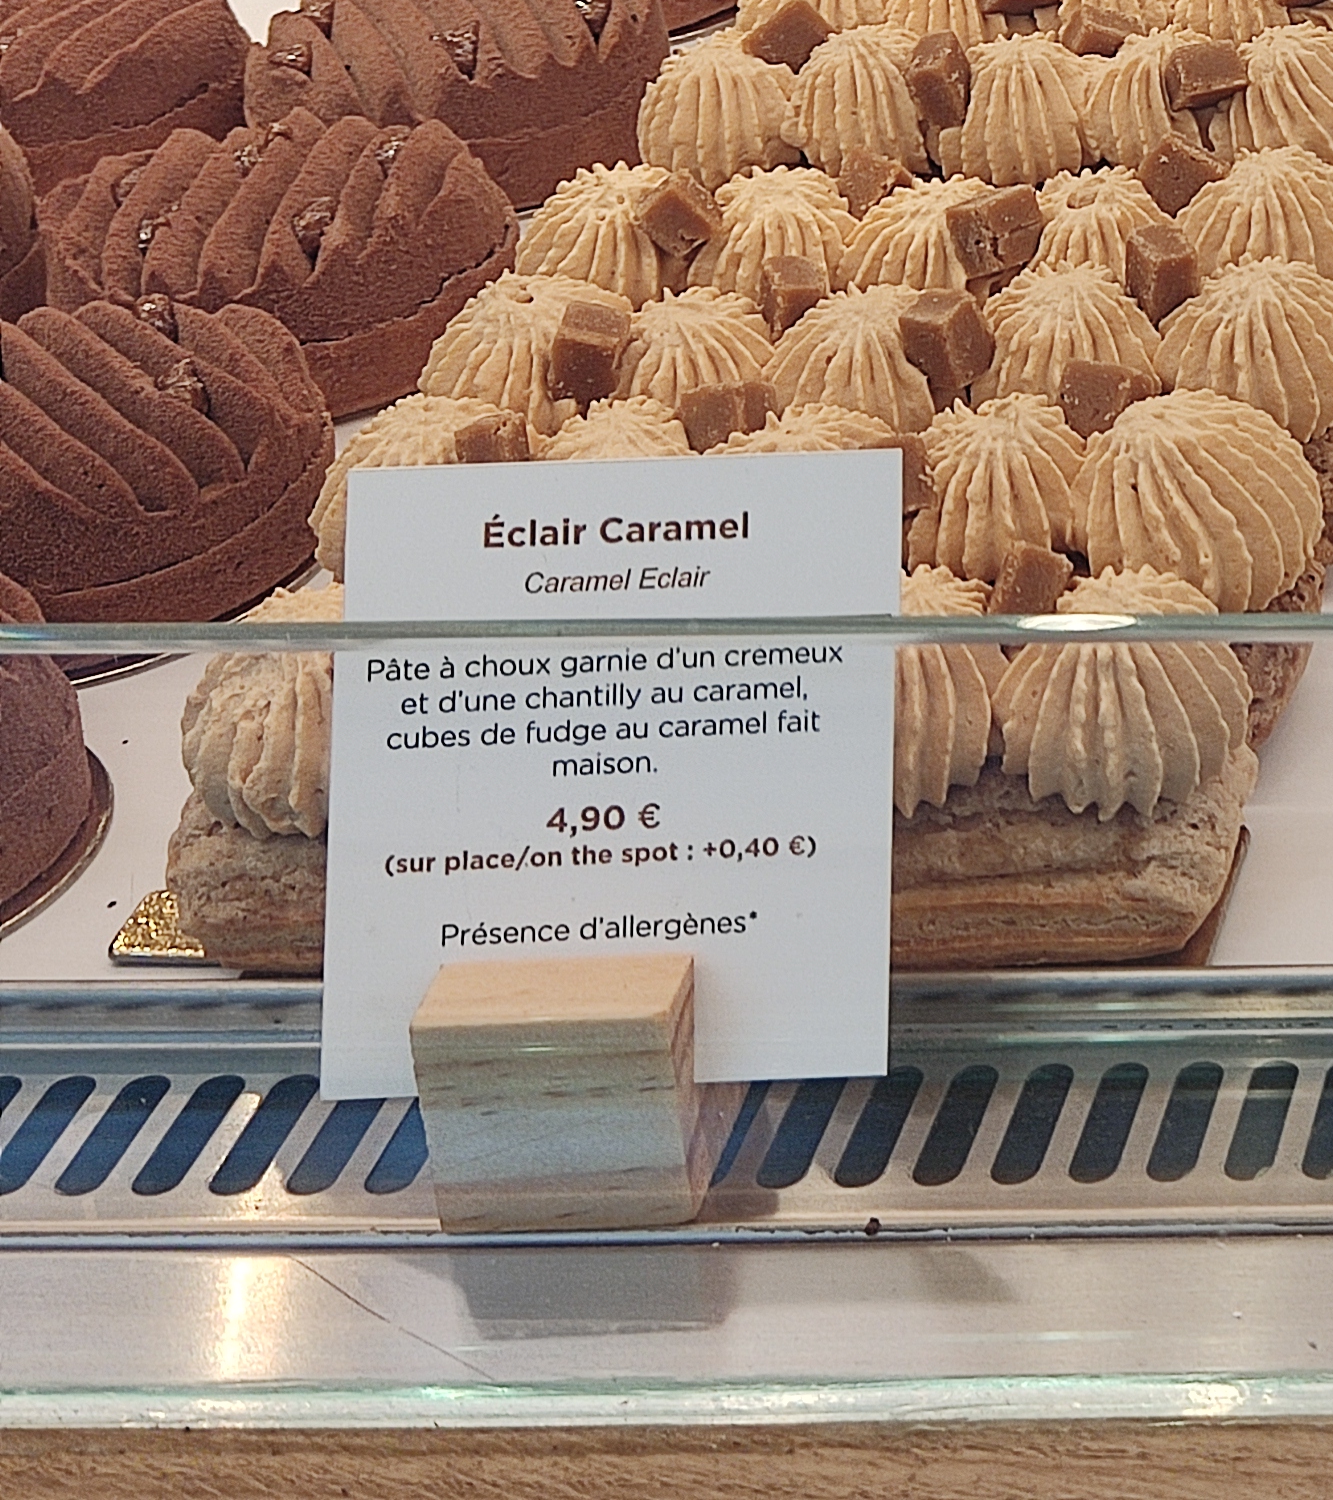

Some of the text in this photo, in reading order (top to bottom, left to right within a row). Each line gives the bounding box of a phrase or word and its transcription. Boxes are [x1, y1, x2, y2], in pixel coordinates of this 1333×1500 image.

[483, 510, 749, 549] Éclair Caramel
[524, 565, 711, 594] Caramel Eclair
[367, 657, 431, 683] Pâte
[439, 655, 455, 680] à
[464, 653, 551, 679] choux
[560, 647, 648, 679] garnie
[656, 646, 715, 670] d'un
[400, 675, 808, 715] et d'une chantilly au caramel,
[386, 709, 821, 751] cubes de fudge au caramel fait
[552, 751, 658, 778] maison.
[546, 802, 661, 839] 4,90 €
[384, 835, 817, 878] (sur place/on the spot : +0,40 €)
[441, 921, 570, 948] Présence
